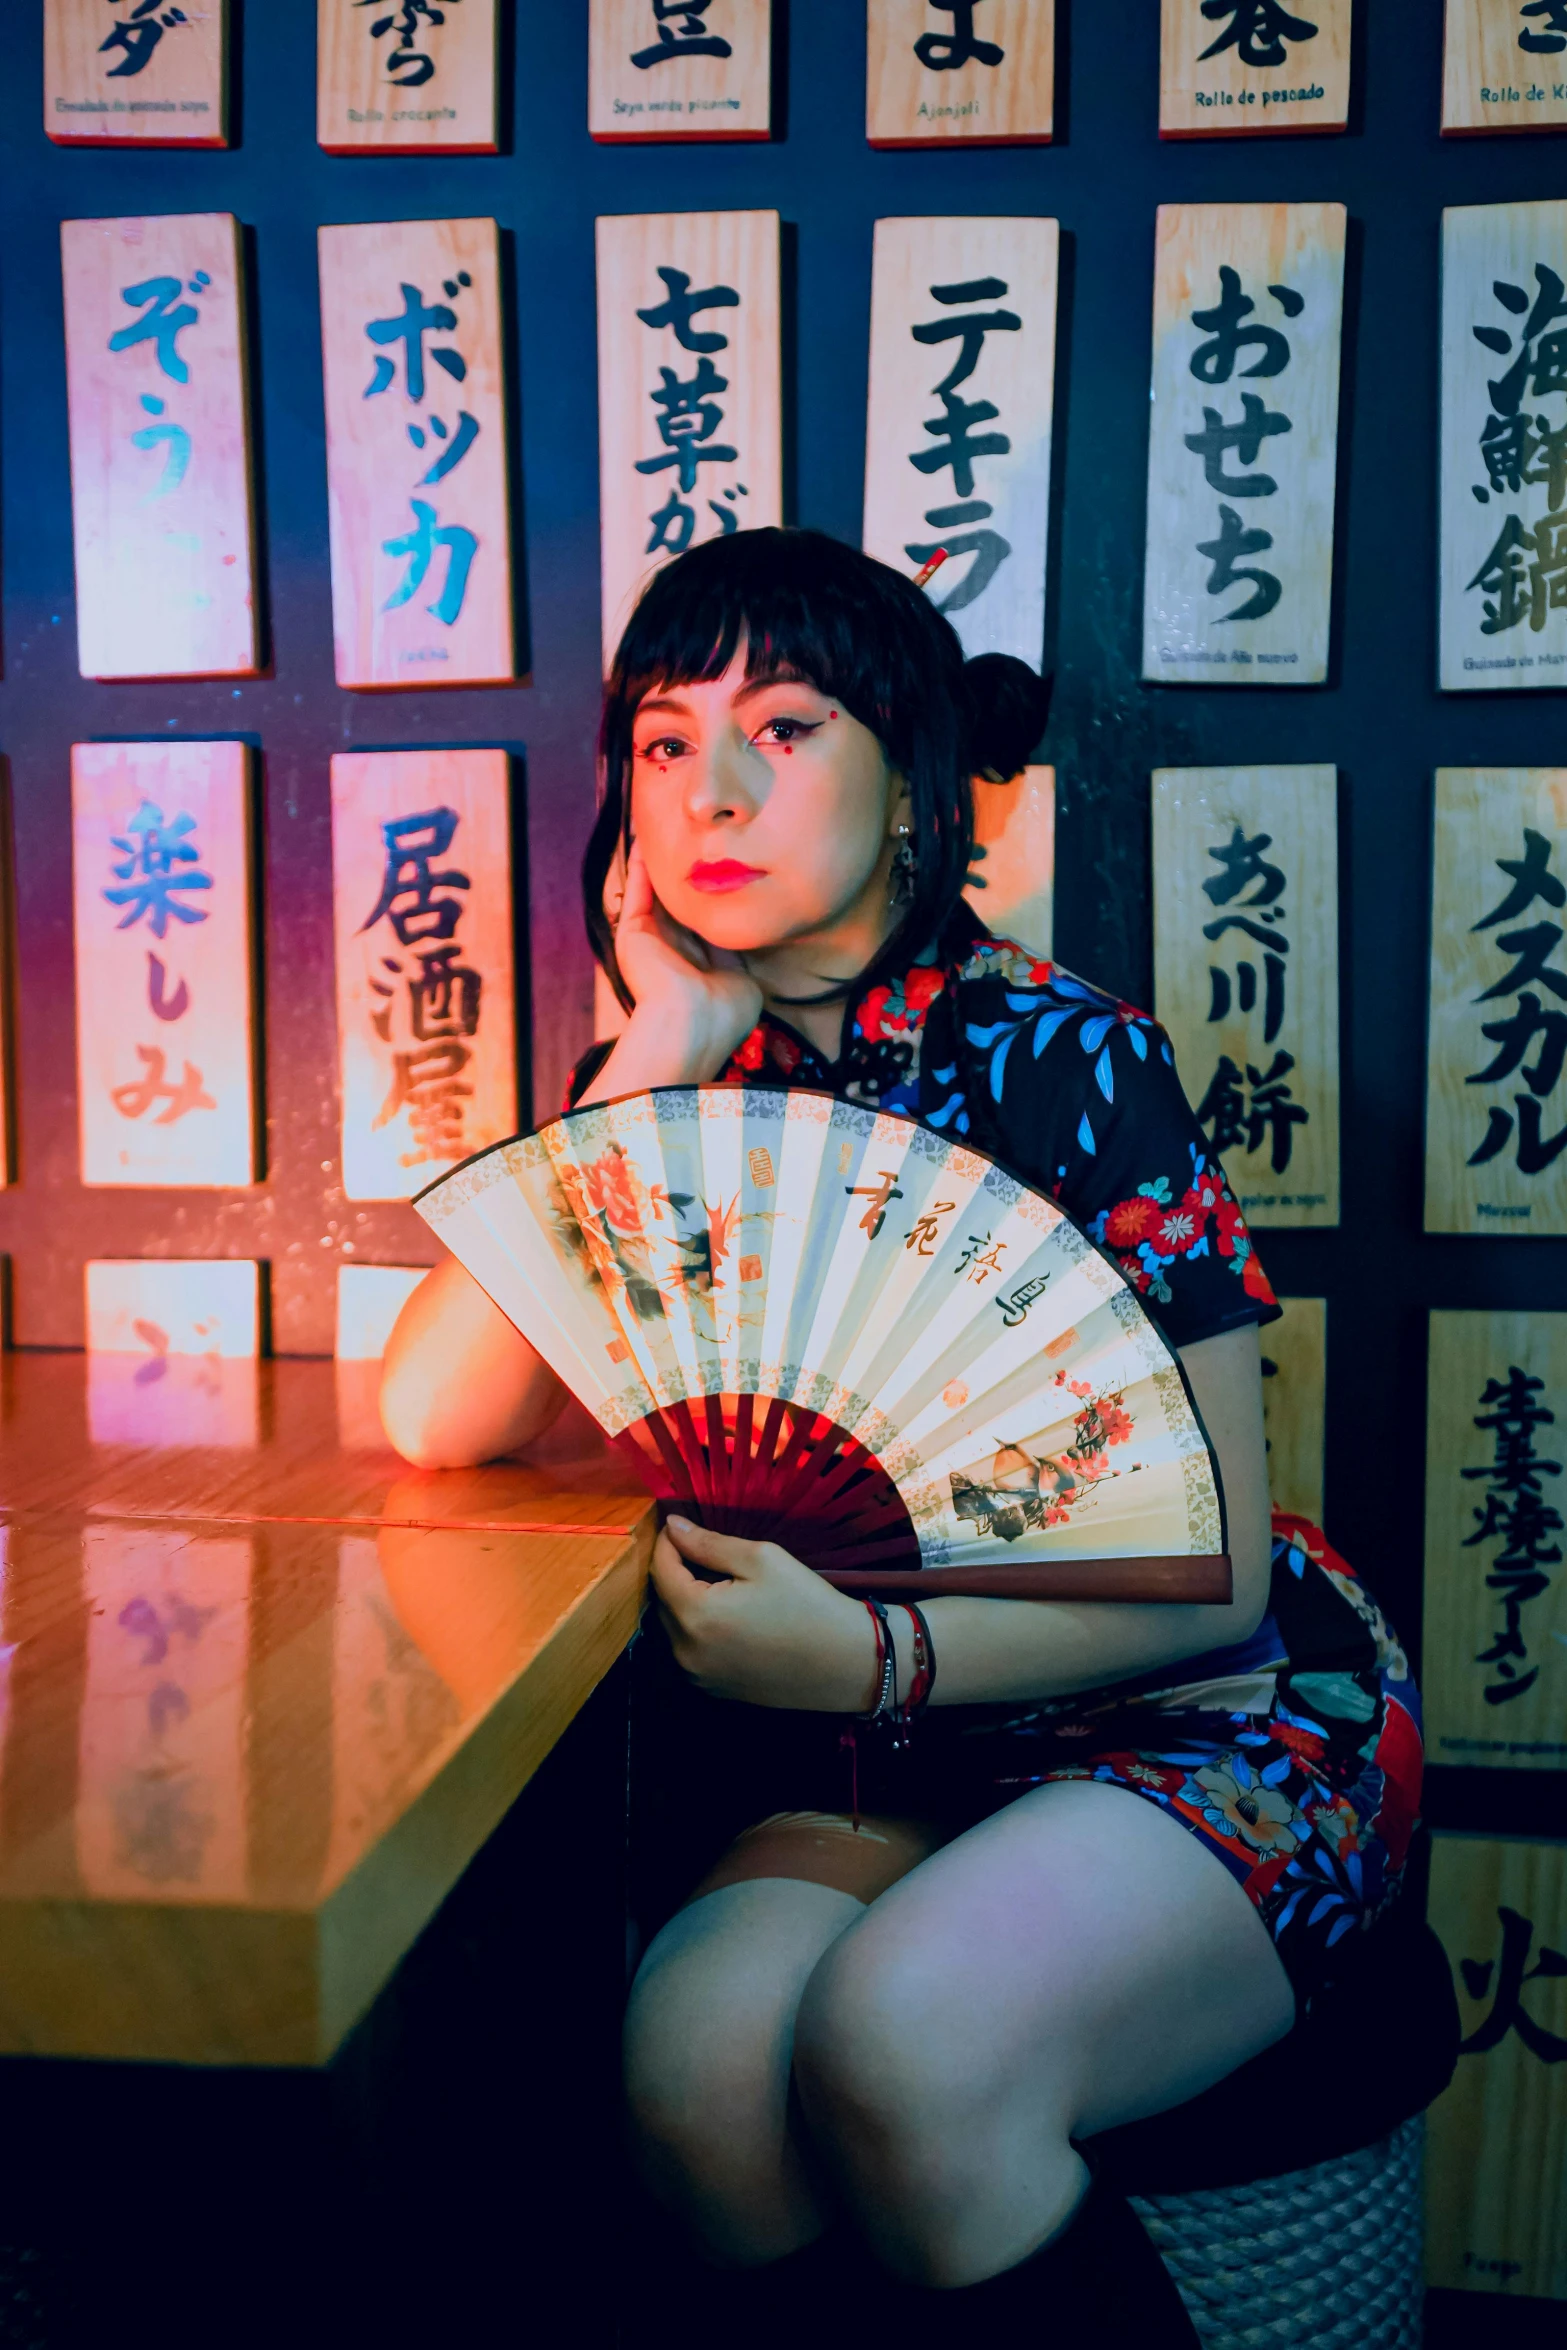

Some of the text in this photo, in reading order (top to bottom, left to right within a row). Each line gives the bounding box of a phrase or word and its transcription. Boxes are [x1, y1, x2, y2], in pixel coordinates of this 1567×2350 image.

[98, 0, 187, 77] ダ
[1195, 83, 1325, 108] Rollo de pescado
[1480, 86, 1520, 103] Rollo
[1525, 84, 1545, 101] de
[904, 276, 1022, 613] テキラ
[1184, 264, 1304, 625] おせち
[102, 799, 217, 1124] 楽しみ
[354, 805, 483, 1168] 居酒屋
[1465, 828, 1567, 1175] メスカル
[1460, 1905, 1567, 2064] 火
